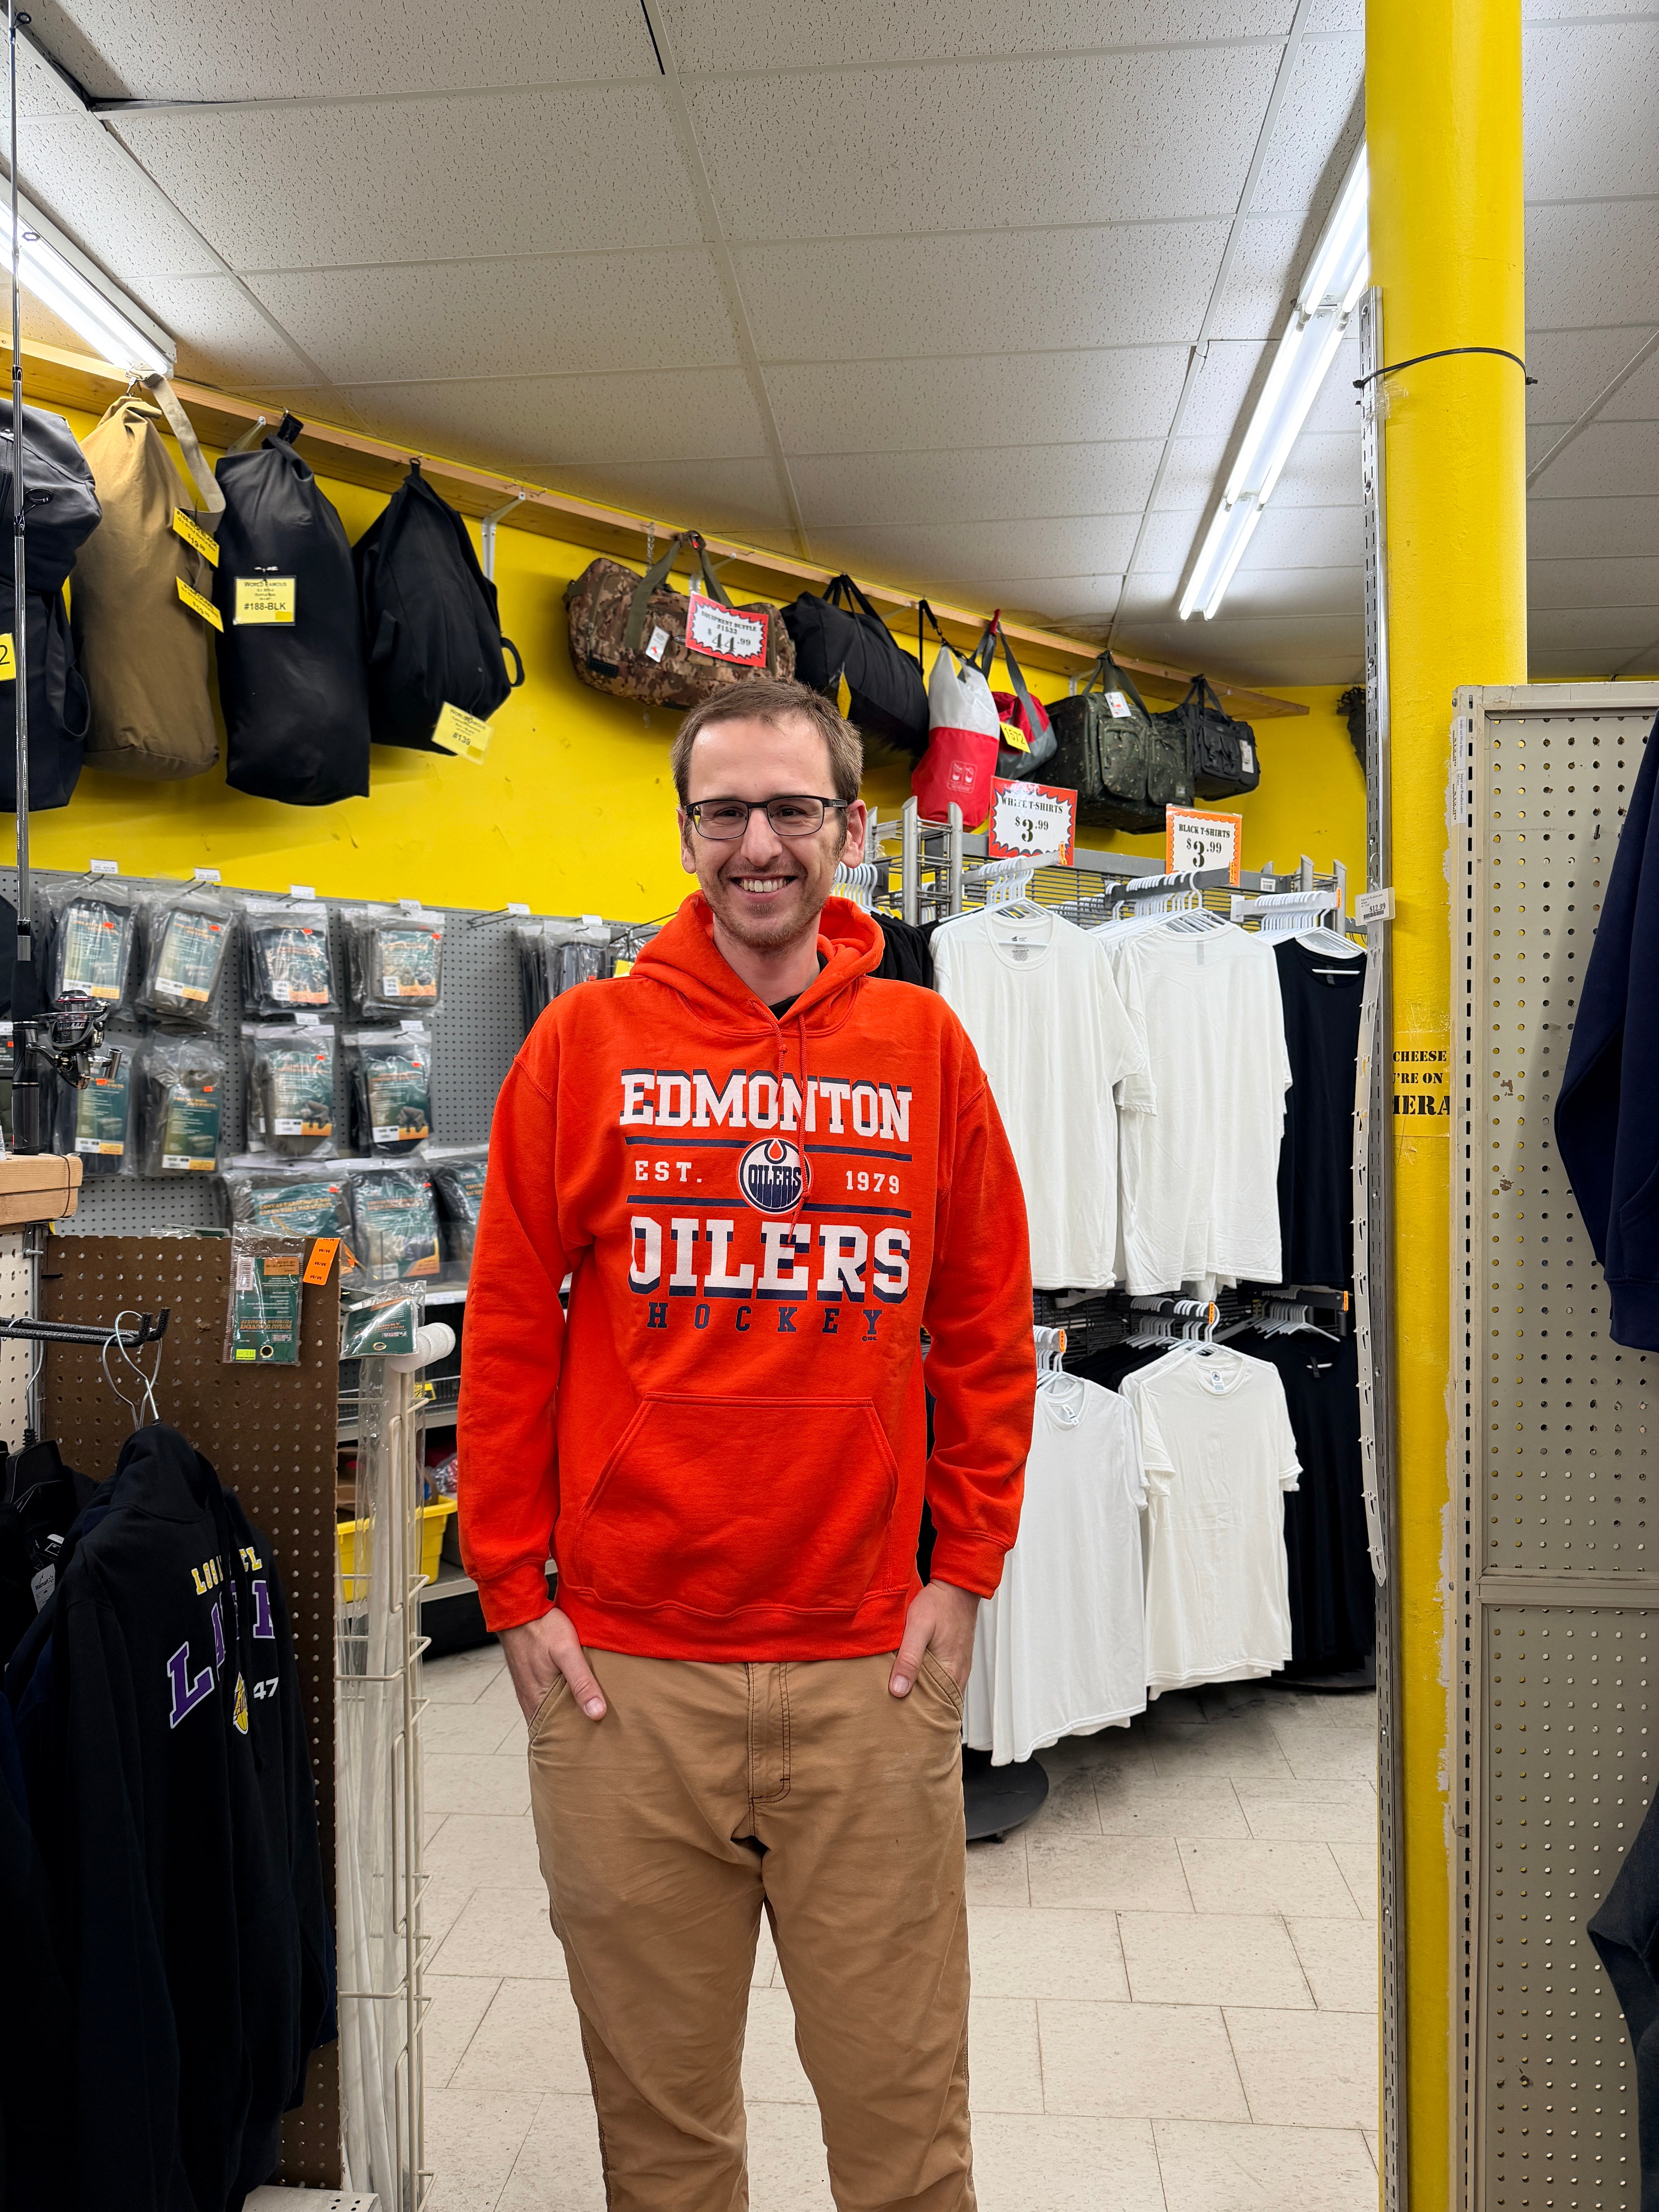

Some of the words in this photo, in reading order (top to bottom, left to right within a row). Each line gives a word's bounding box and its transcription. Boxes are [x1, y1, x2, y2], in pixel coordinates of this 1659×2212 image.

[1004, 727, 1026, 745] 1572
[1001, 797, 1027, 808] WHITE
[1029, 801, 1063, 814] T-SHIRTS
[1179, 824, 1199, 834] BLACK
[1200, 827, 1230, 838] T-SHIRTS
[1369, 902, 1386, 912] $12.99
[1393, 1051, 1447, 1062] CHEESE
[1393, 1072, 1419, 1084] 'RE
[1422, 1072, 1443, 1084] ON
[620, 1068, 912, 1142] EDMONTON
[635, 1160, 702, 1183] EST.
[846, 1170, 900, 1194] 1979
[748, 1164, 802, 1207] OILERS
[628, 1215, 911, 1304] OILERS
[647, 1302, 882, 1335] HOCKEY
[253, 1676, 280, 1700] 47
